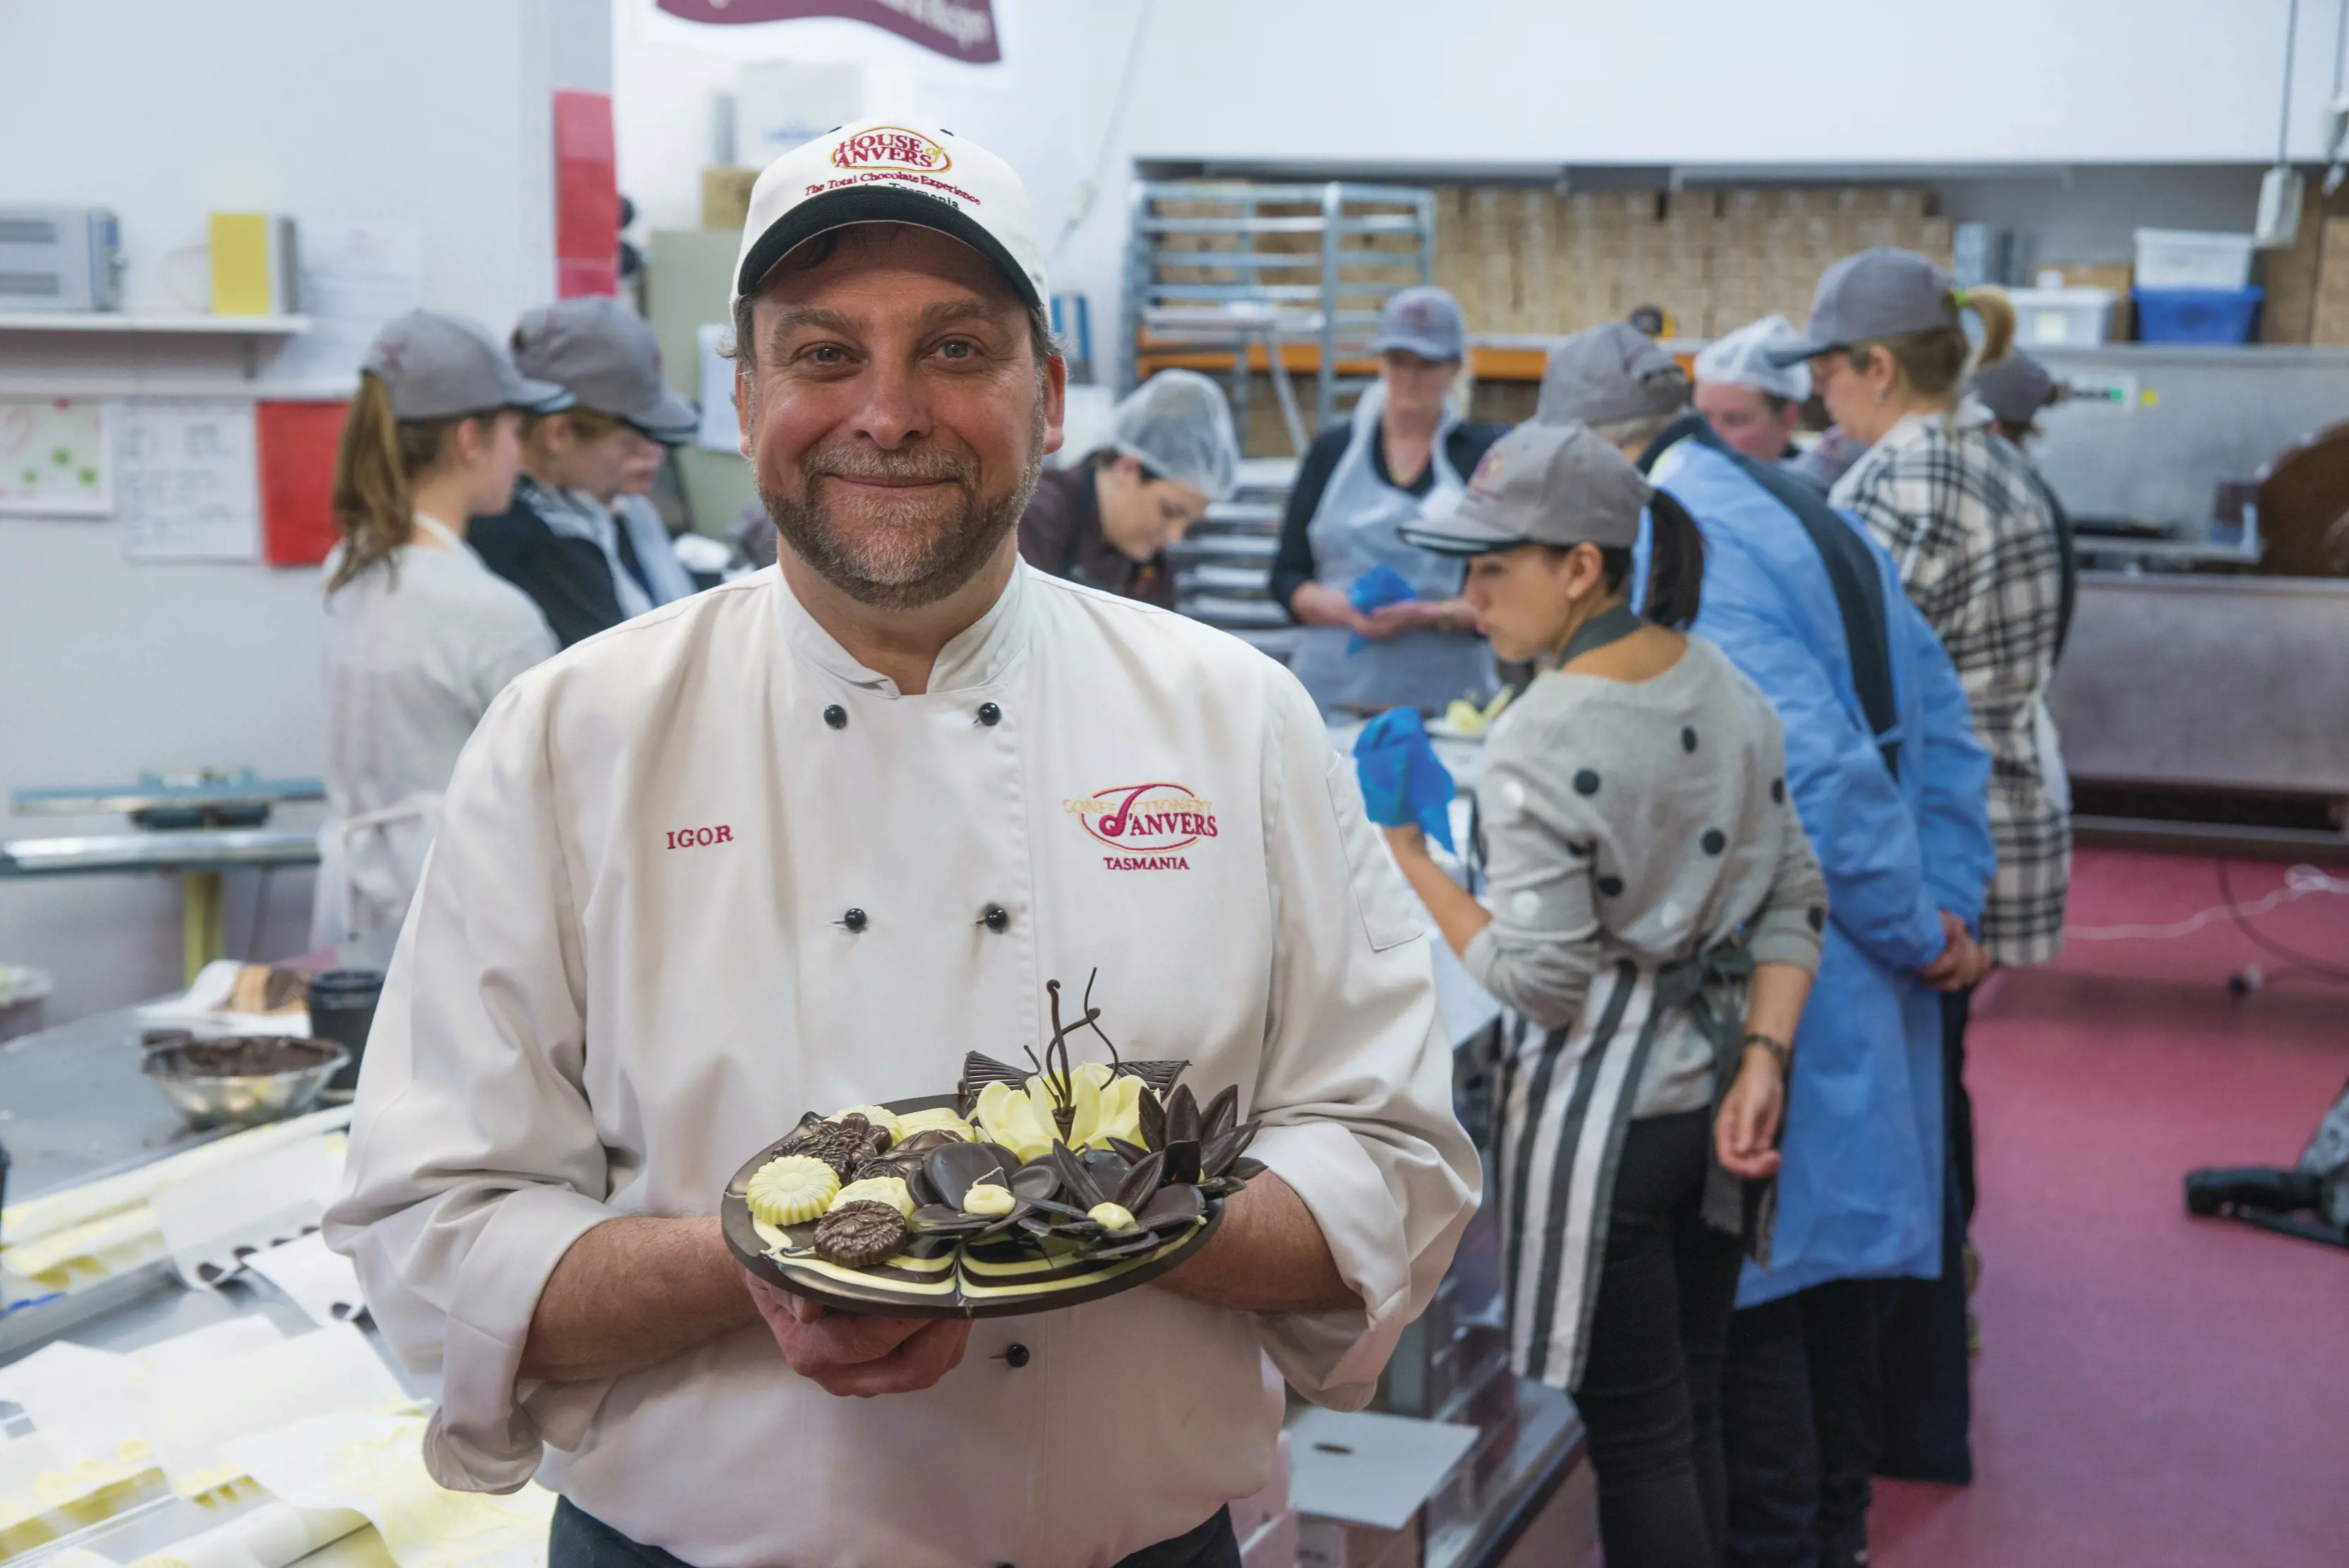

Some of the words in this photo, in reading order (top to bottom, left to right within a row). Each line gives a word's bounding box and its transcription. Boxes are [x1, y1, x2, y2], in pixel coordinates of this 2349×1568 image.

[835, 147, 932, 168] ANVERS
[837, 134, 923, 154] HOUSE
[925, 147, 946, 164] of
[805, 183, 825, 196] The
[827, 175, 857, 189] Total
[860, 171, 919, 183] Chocolate
[920, 175, 981, 205] Experience
[666, 825, 734, 850] IGOR
[1104, 857, 1190, 871] TASMANIA
